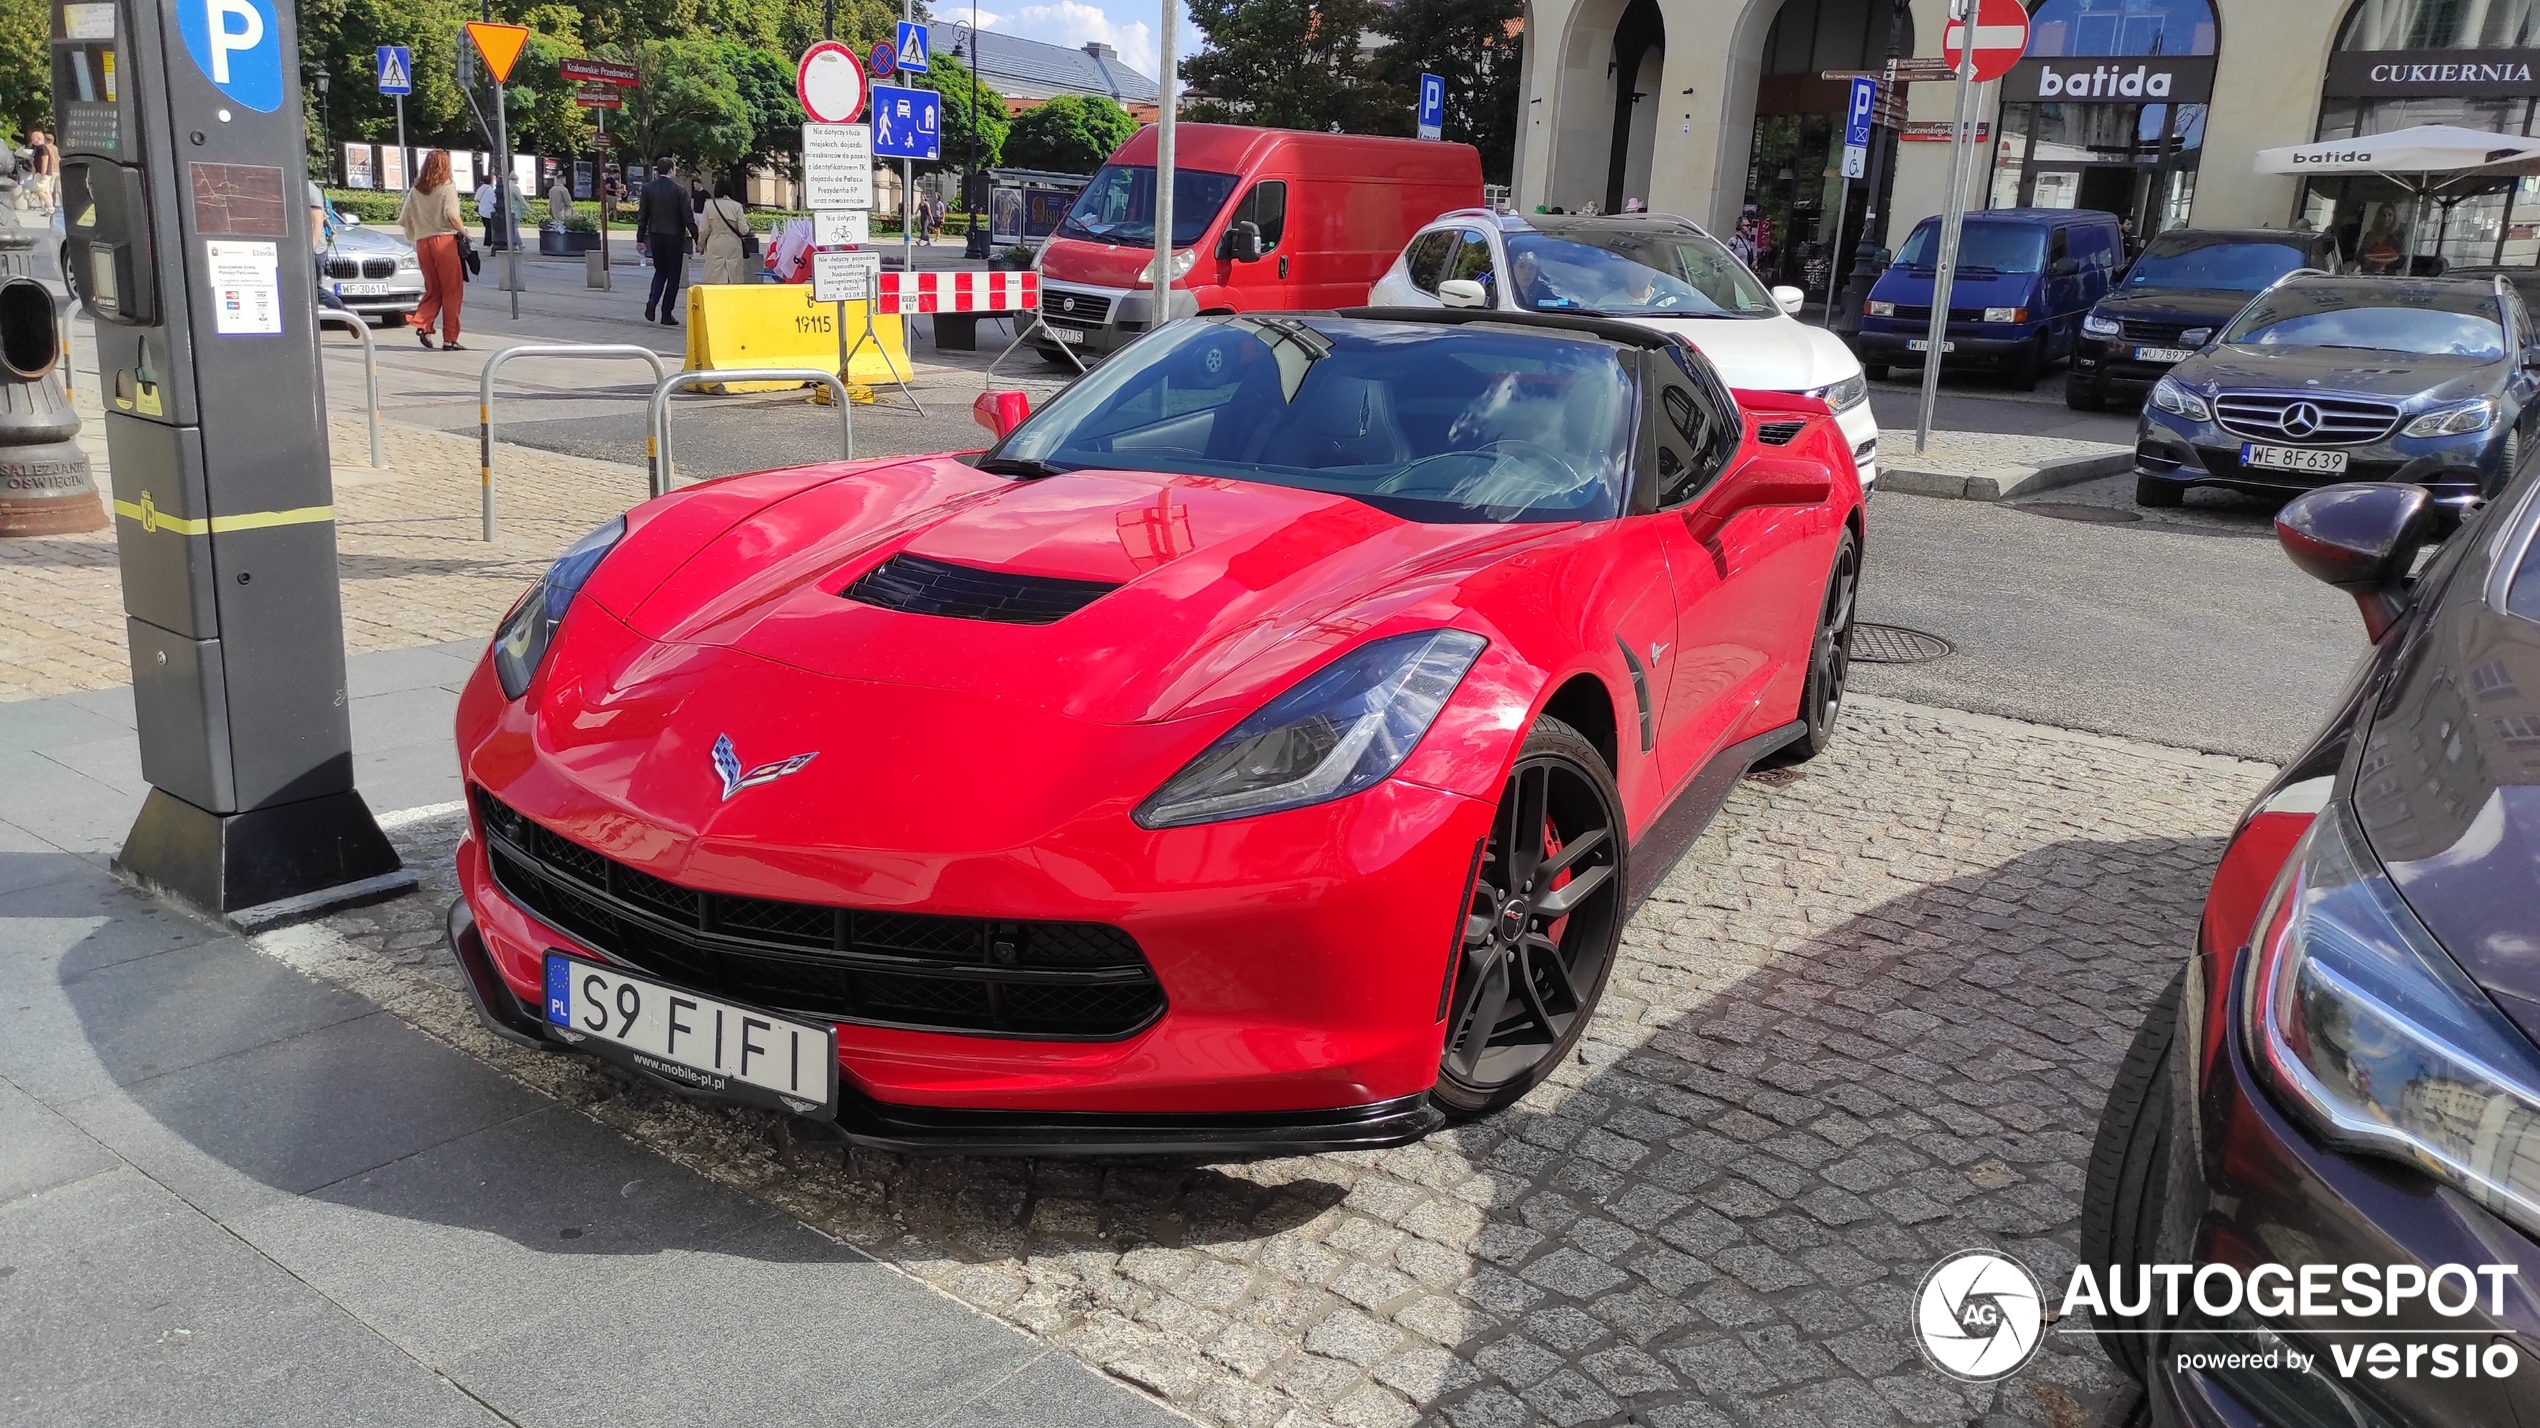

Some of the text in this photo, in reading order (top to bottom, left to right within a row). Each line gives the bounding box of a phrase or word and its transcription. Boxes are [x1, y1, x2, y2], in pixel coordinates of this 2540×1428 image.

[206, 0, 264, 84] P
[567, 63, 634, 79] Krakowskie Przedmieście
[2370, 63, 2533, 82] CUKIERNIA
[2039, 65, 2173, 97] batida
[1425, 81, 1439, 119] P
[1853, 84, 1870, 126] P
[812, 127, 823, 135] Nie
[824, 128, 845, 138] dotyczy
[809, 140, 863, 149] miejskich, dojazdu
[850, 151, 870, 161] posesji
[2293, 151, 2371, 163] batida
[812, 163, 859, 172] identyfikatorem
[810, 175, 833, 184] dojazdu
[817, 186, 849, 195] Prezydenta
[825, 214, 857, 223] Nie dotyczy
[359, 284, 387, 294] 3061A
[795, 315, 832, 334] 19115
[2141, 348, 2158, 359] WU
[2253, 446, 2342, 470] WE 8F639
[0, 461, 85, 476] SALEZJANIE
[551, 998, 567, 1017] PL
[583, 974, 798, 1092] S9 FIFI
[633, 1053, 725, 1091] www.mobile-pl.pl
